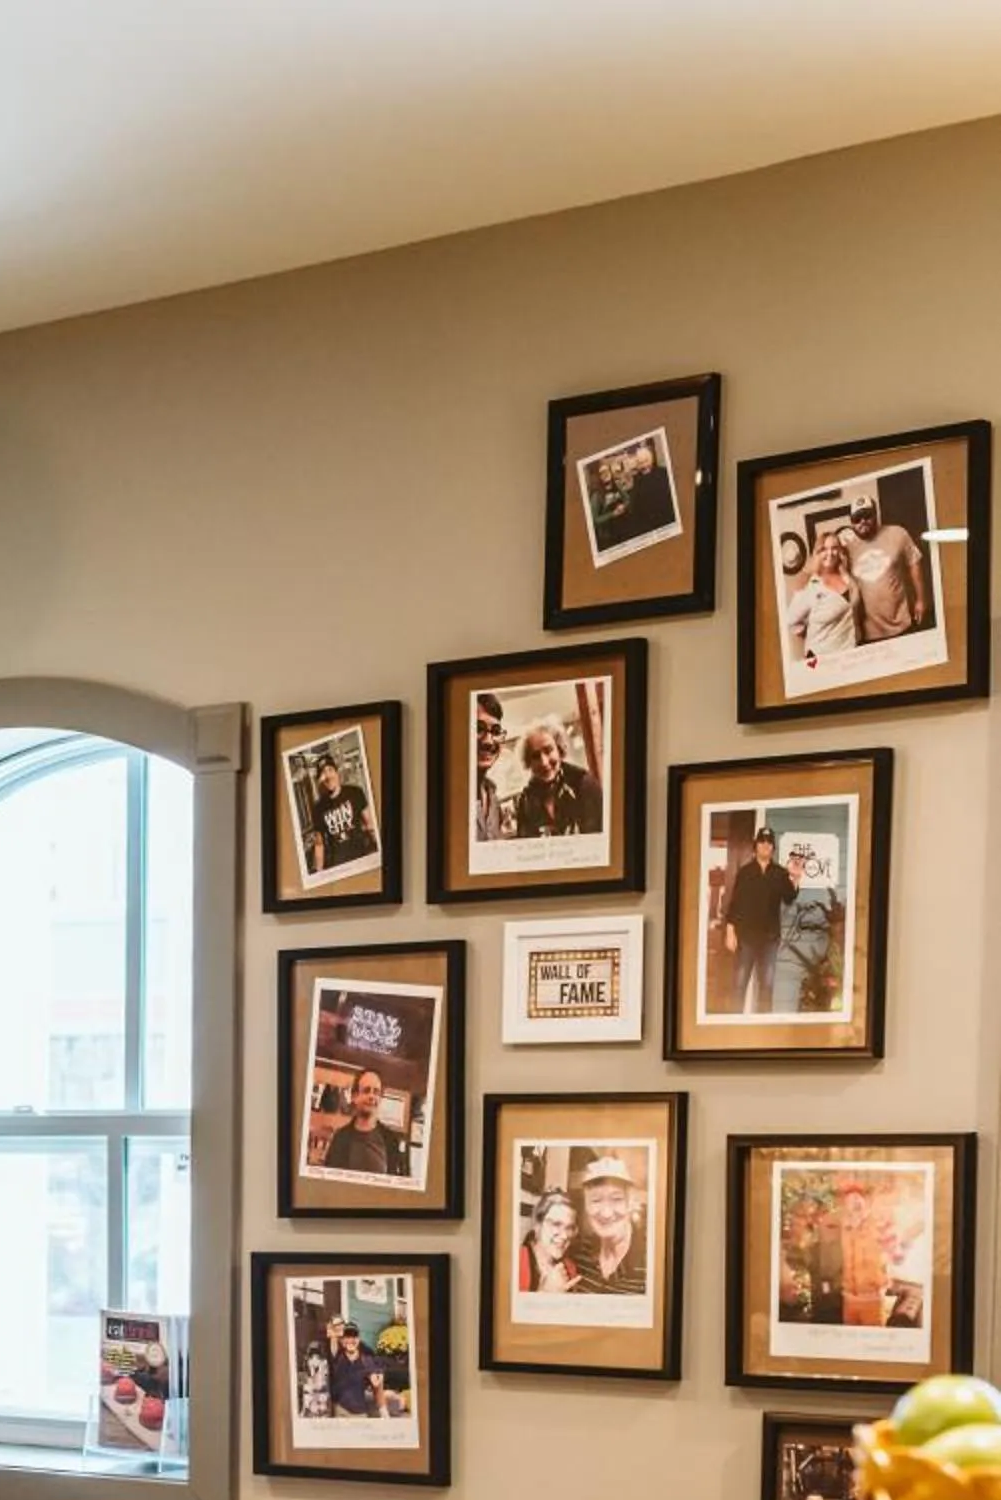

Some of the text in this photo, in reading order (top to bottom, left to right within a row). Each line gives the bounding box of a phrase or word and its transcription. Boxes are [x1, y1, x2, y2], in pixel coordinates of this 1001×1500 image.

[541, 963, 592, 981] WALL OF
[560, 981, 607, 1004] FAME
